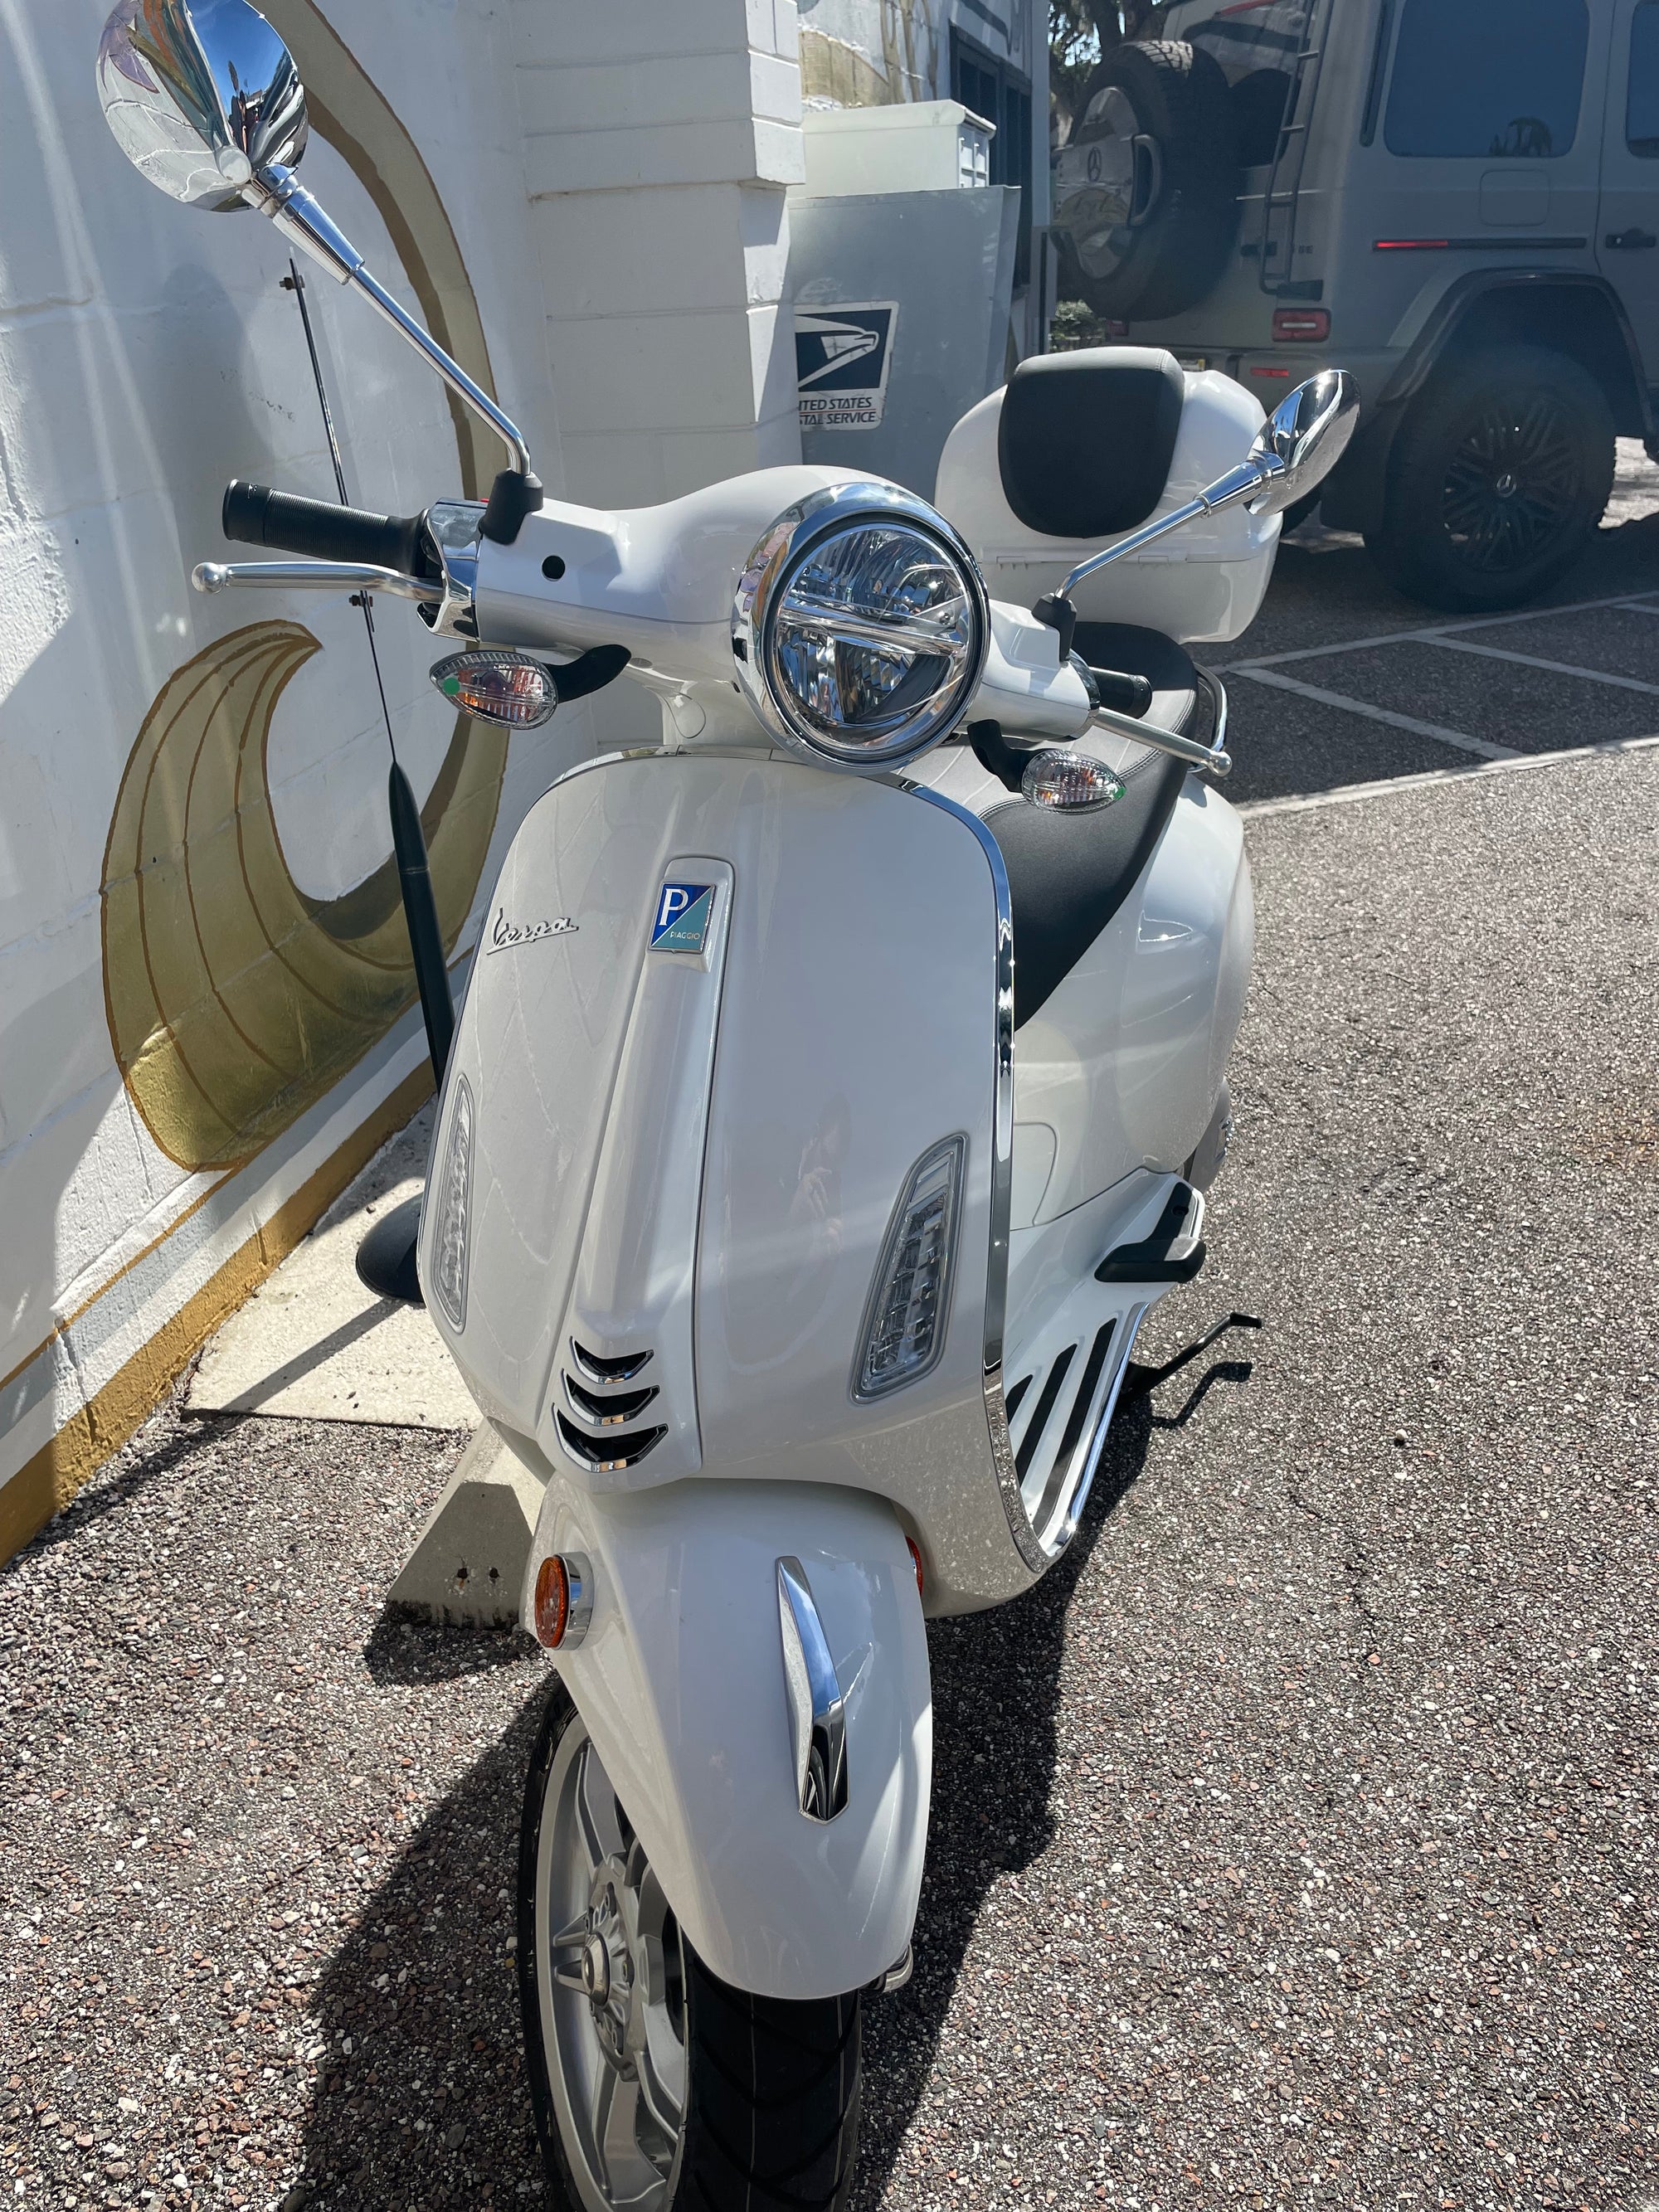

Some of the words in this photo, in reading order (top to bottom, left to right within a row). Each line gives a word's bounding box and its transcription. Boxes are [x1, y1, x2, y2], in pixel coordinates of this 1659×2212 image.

[798, 399, 827, 411] ITED
[829, 397, 873, 409] STATES
[800, 415, 824, 425] TAL
[826, 411, 877, 424] SERVICE
[659, 888, 688, 926] P
[486, 907, 580, 955] Vespa
[670, 931, 701, 940] PIAGGIO
